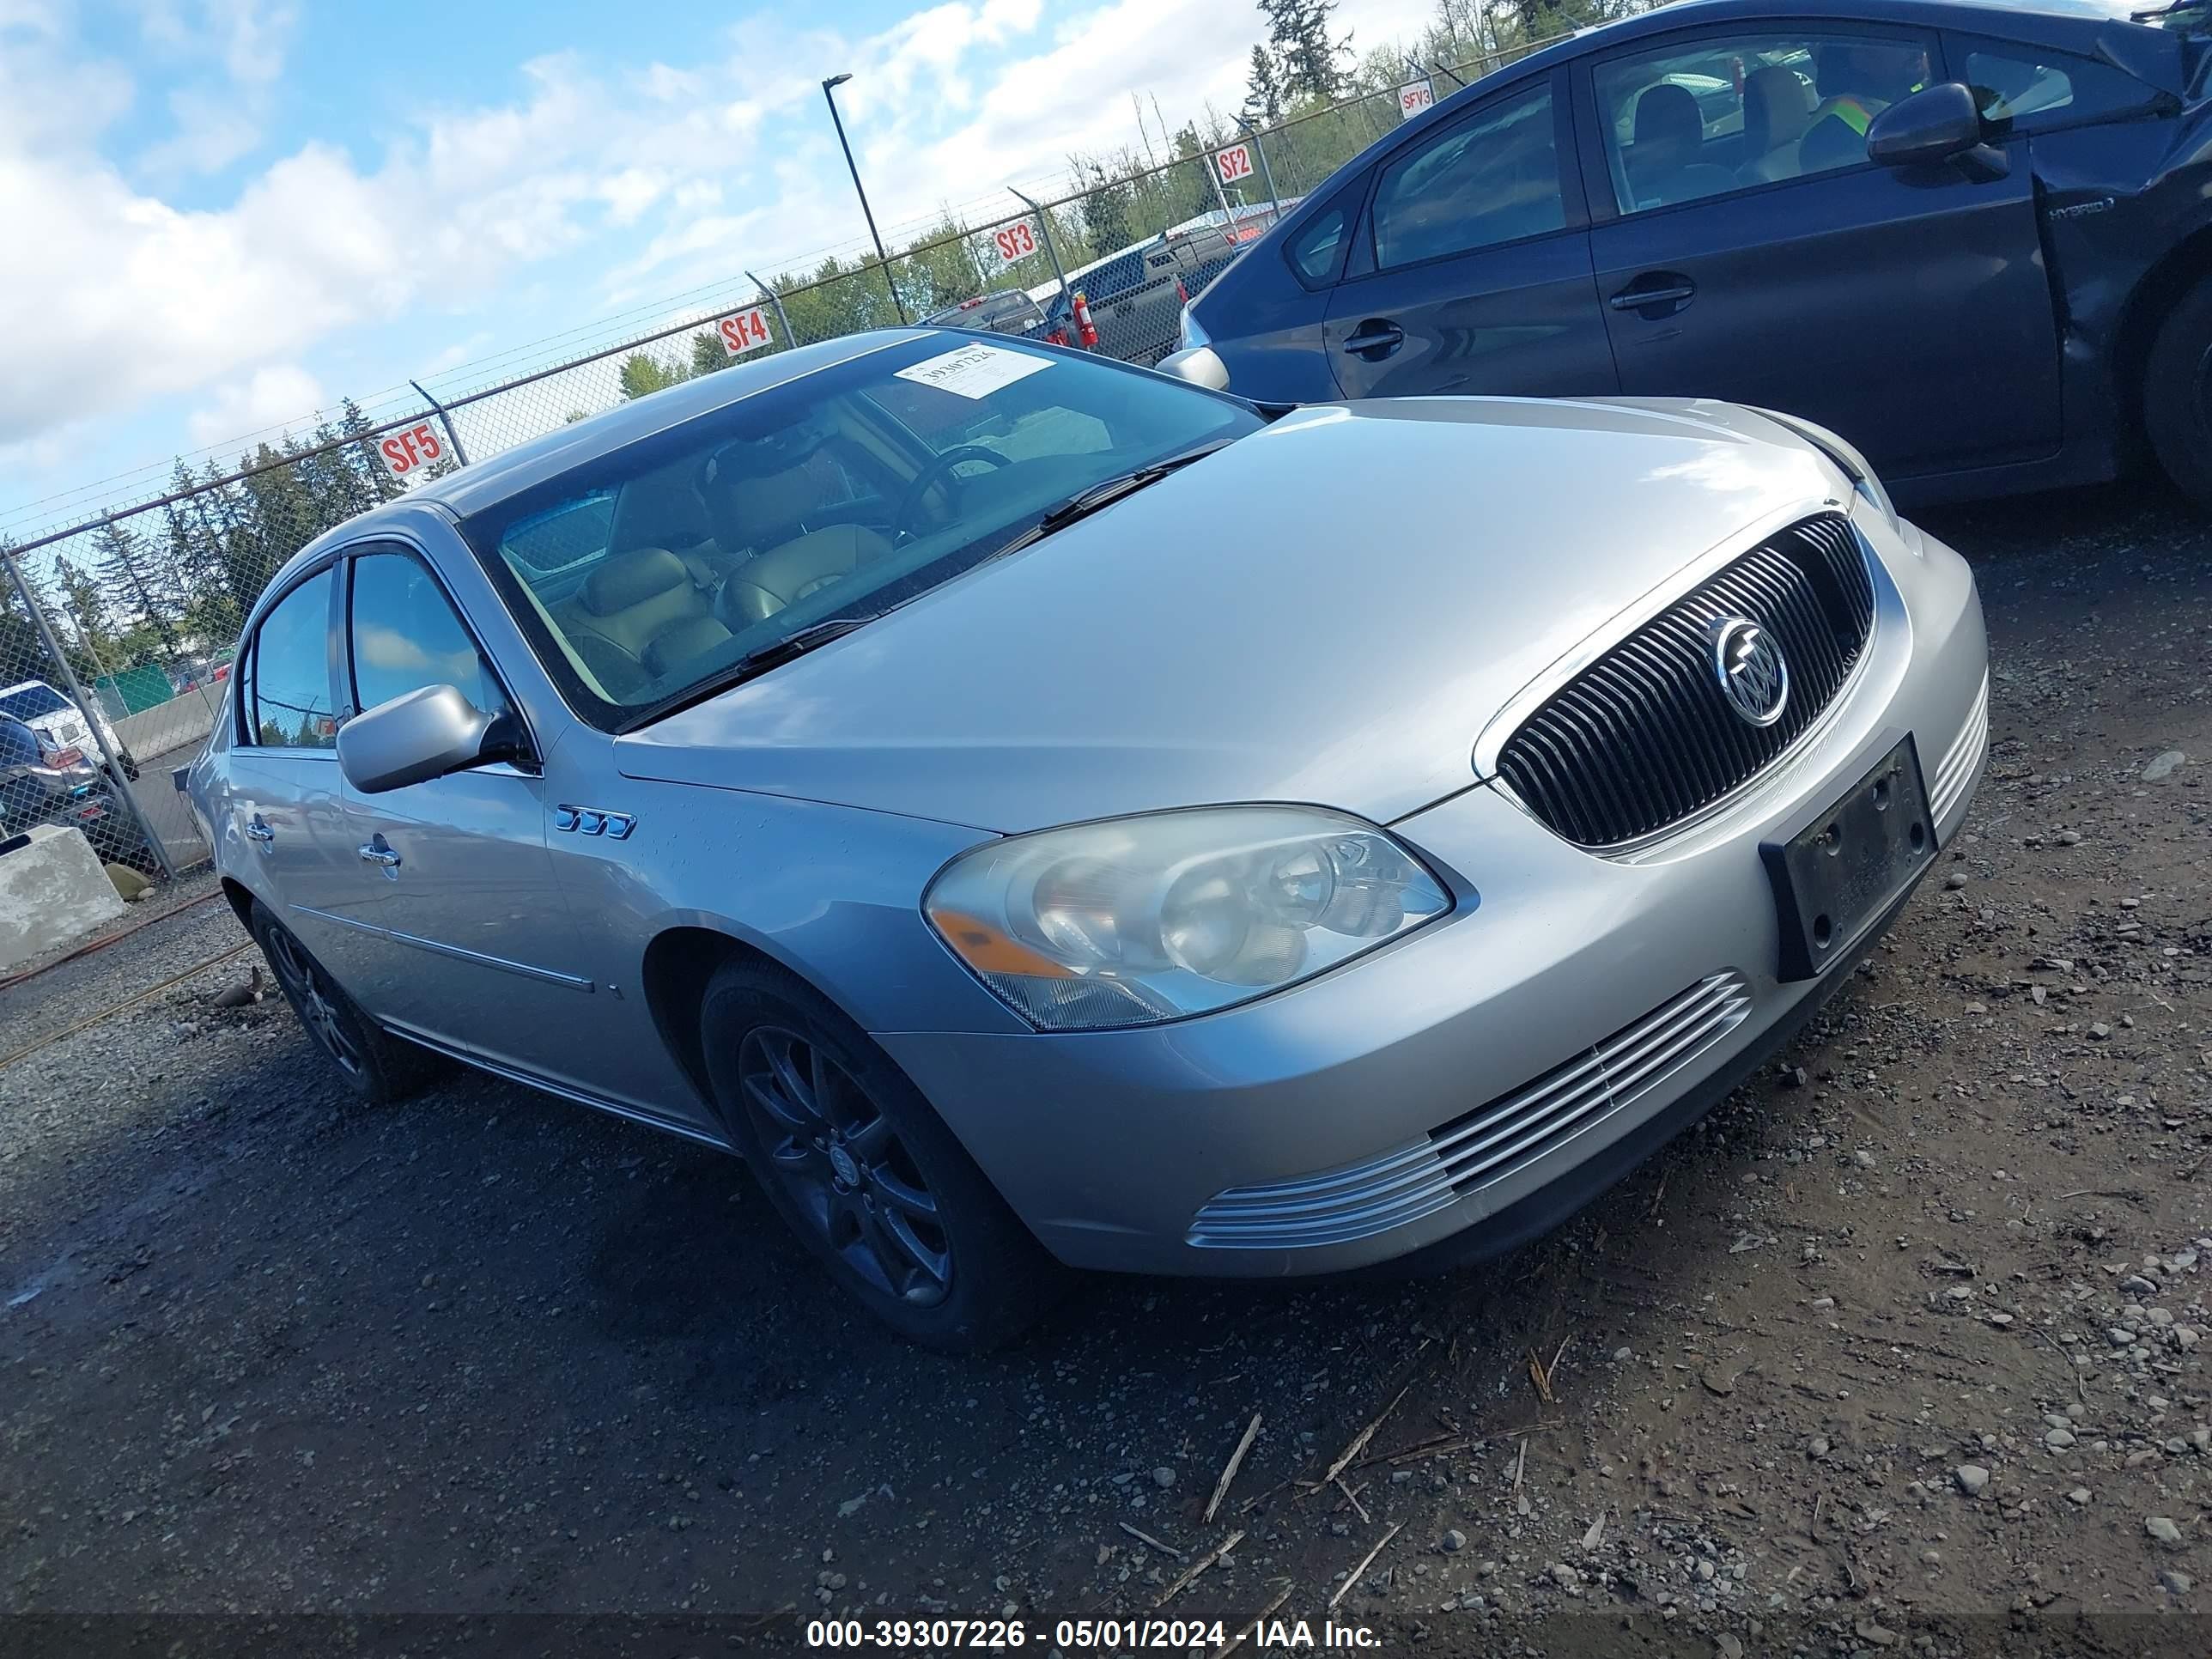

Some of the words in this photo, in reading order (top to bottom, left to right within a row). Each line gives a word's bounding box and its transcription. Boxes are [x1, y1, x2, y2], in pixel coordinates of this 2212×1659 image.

[1403, 88, 1431, 110] SFV3
[1219, 148, 1250, 179] SF2
[2049, 200, 2105, 221] HYBRID
[997, 224, 1034, 259] SF3
[721, 311, 767, 351] SF4
[922, 349, 997, 381] 39307226
[382, 424, 441, 473] SF5
